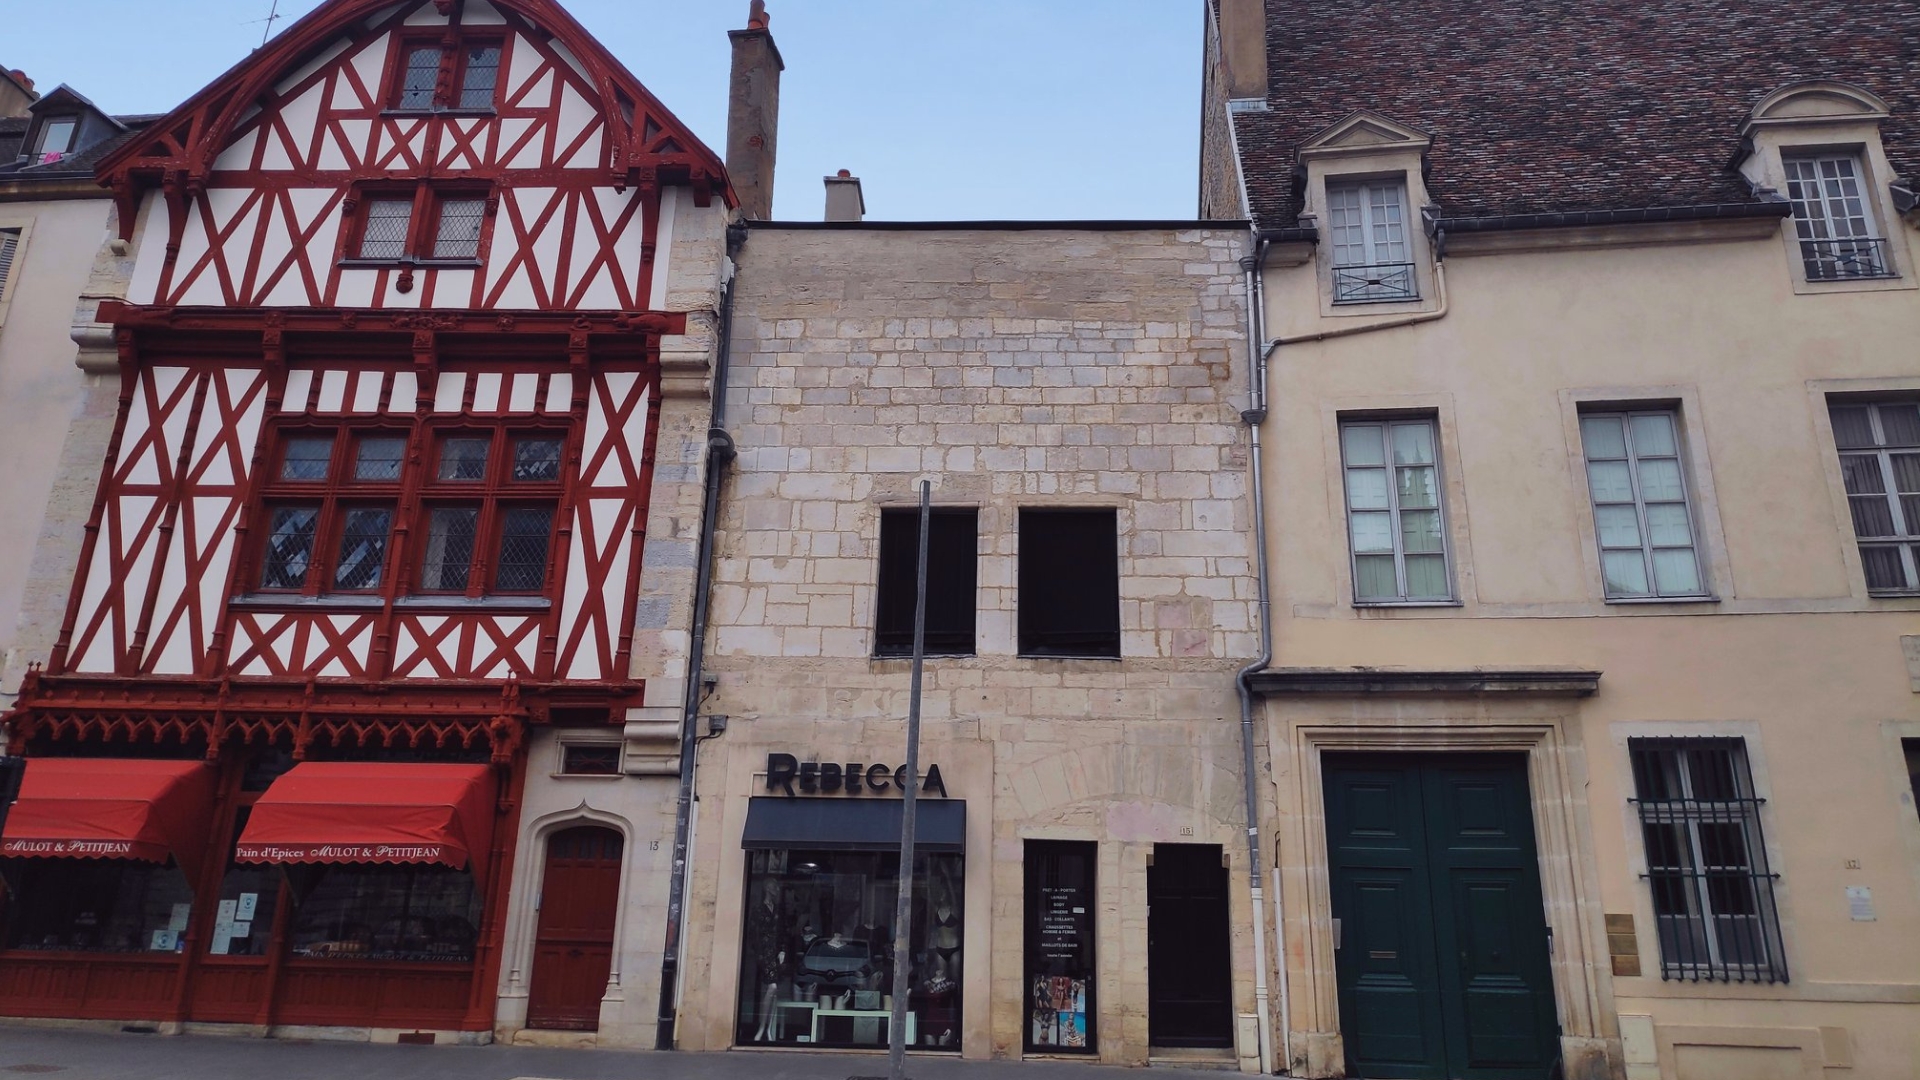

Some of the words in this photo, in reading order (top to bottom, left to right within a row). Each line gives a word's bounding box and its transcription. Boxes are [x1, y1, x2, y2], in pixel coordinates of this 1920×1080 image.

[766, 753, 947, 797] REBECCA
[4, 840, 52, 852] MULOT
[54, 842, 64, 852] &
[67, 840, 131, 854] PETITJEAN
[236, 847, 258, 858] Pain
[261, 847, 304, 860] d'Epices
[310, 845, 360, 858] MULOT
[362, 848, 372, 858] &
[376, 845, 441, 859] PETITJEAN
[649, 840, 659, 851] 13
